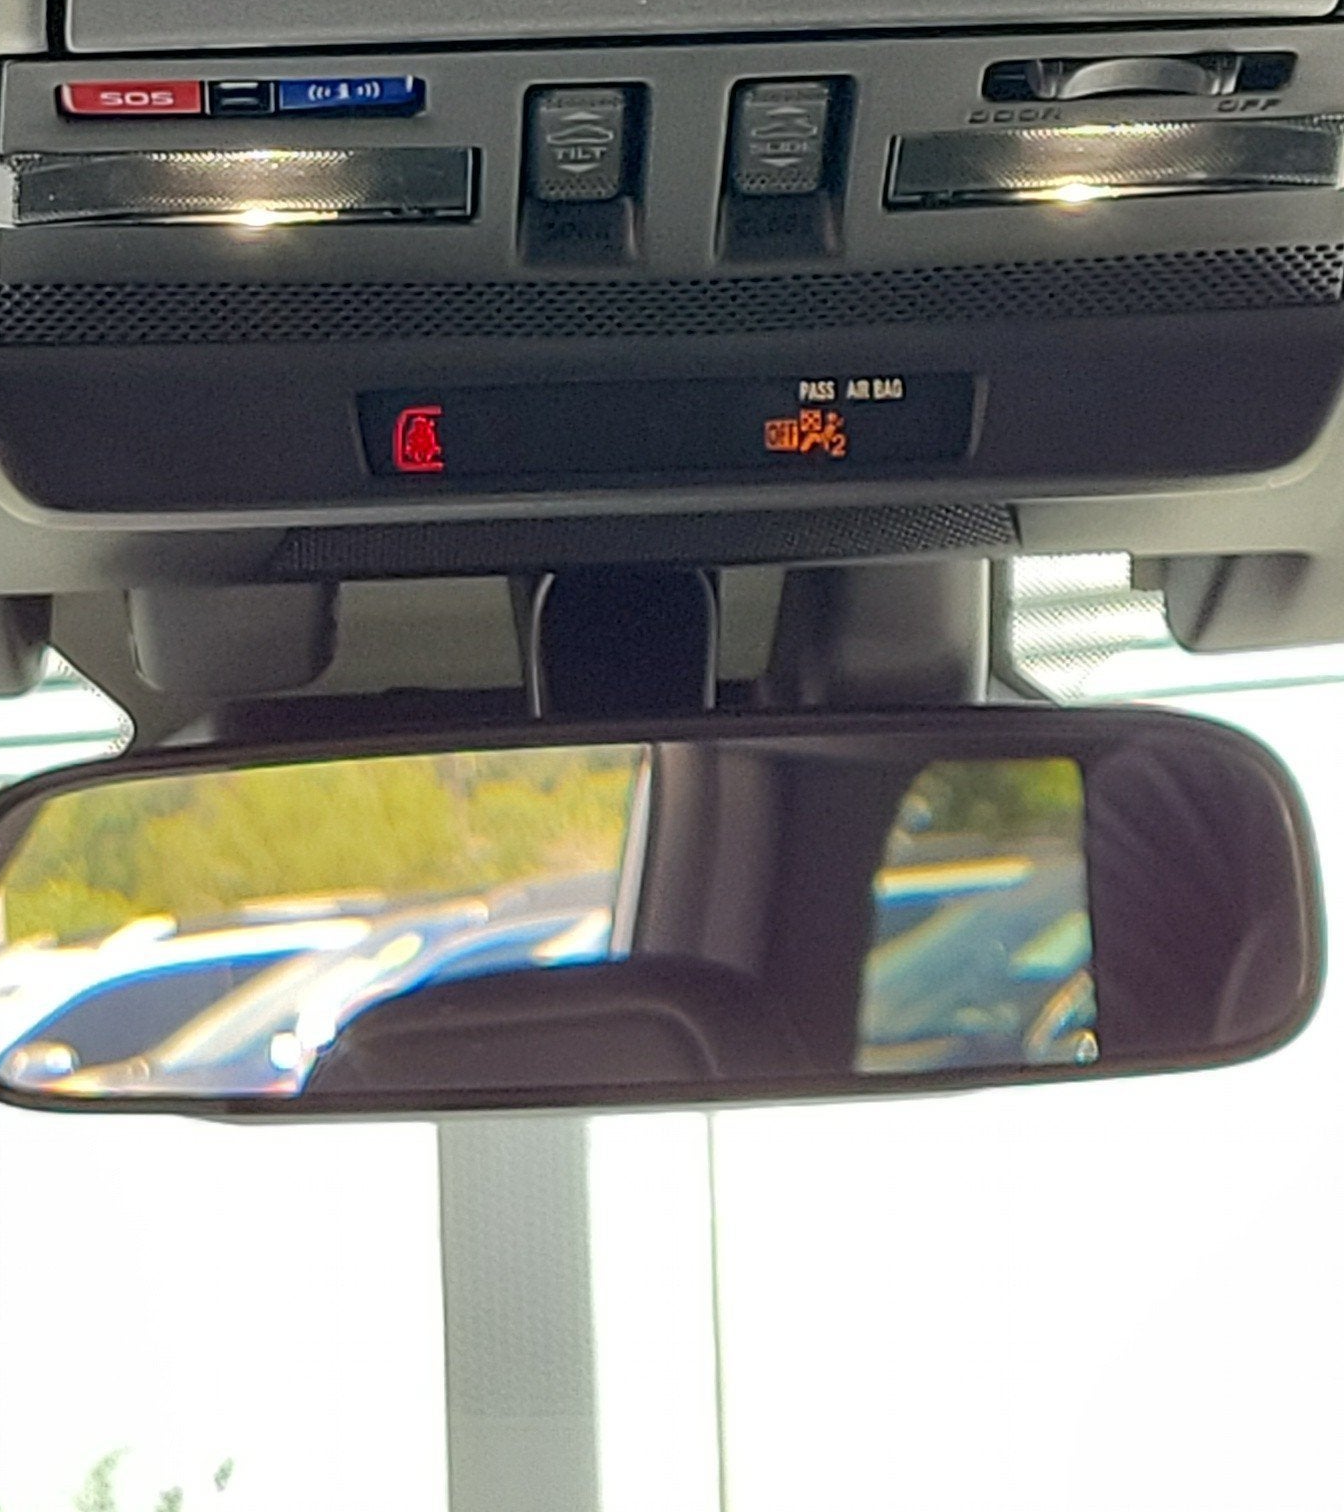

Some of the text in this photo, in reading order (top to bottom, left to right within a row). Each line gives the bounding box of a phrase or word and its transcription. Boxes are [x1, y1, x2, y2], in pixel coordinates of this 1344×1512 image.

[99, 90, 174, 107] SOS
[1215, 97, 1282, 114] OFF
[554, 145, 607, 161] TILT
[799, 380, 836, 400] PASS
[846, 379, 870, 399] AIR
